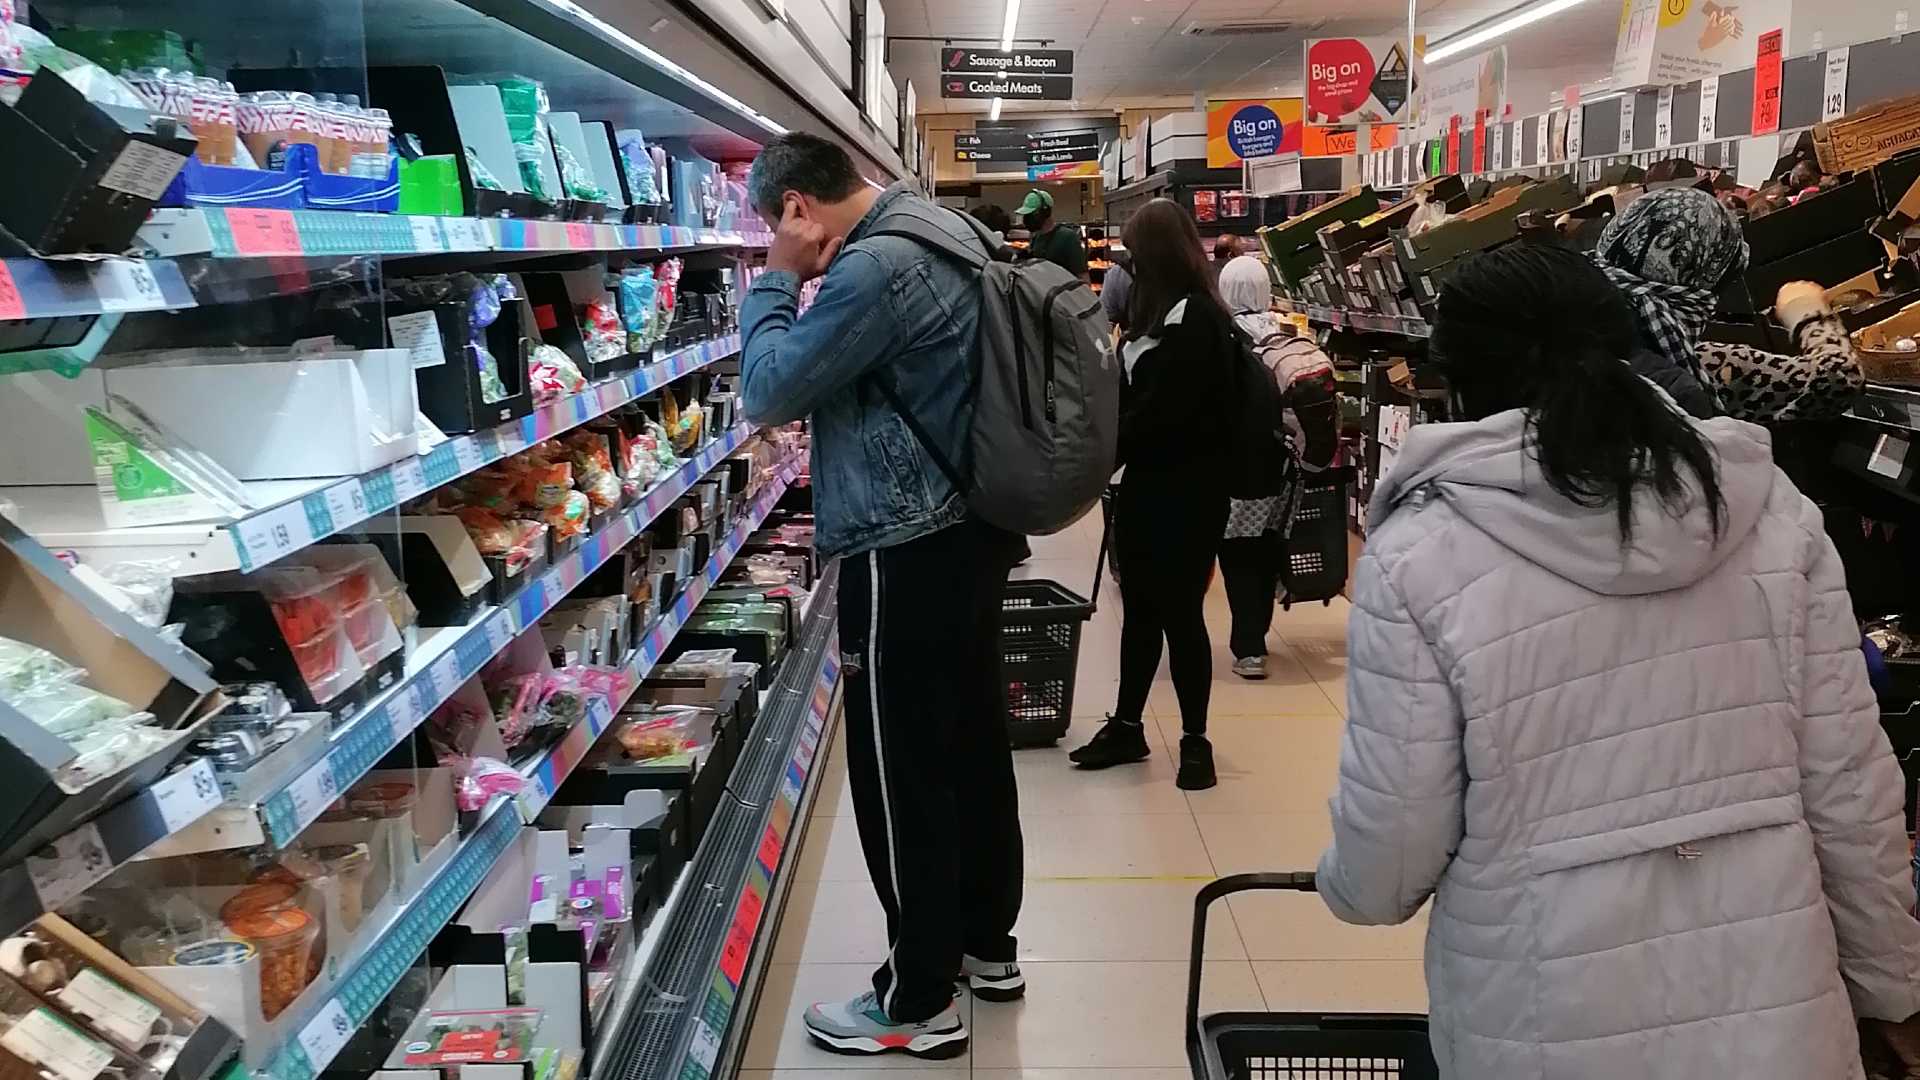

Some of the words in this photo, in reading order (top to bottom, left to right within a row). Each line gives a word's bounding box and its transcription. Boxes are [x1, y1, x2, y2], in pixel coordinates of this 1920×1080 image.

[969, 54, 1013, 69] Sausage
[1014, 55, 1023, 67] &
[1024, 55, 1056, 68] Bacon
[1312, 63, 1337, 82] Big
[1341, 63, 1360, 76] on
[969, 80, 1010, 93] Cooked
[1010, 82, 1042, 94] Meats
[1826, 93, 1842, 115] 1.29
[1233, 120, 1256, 136] Big
[1258, 119, 1277, 131] on
[969, 137, 981, 145] Fish
[1331, 136, 1355, 150] We
